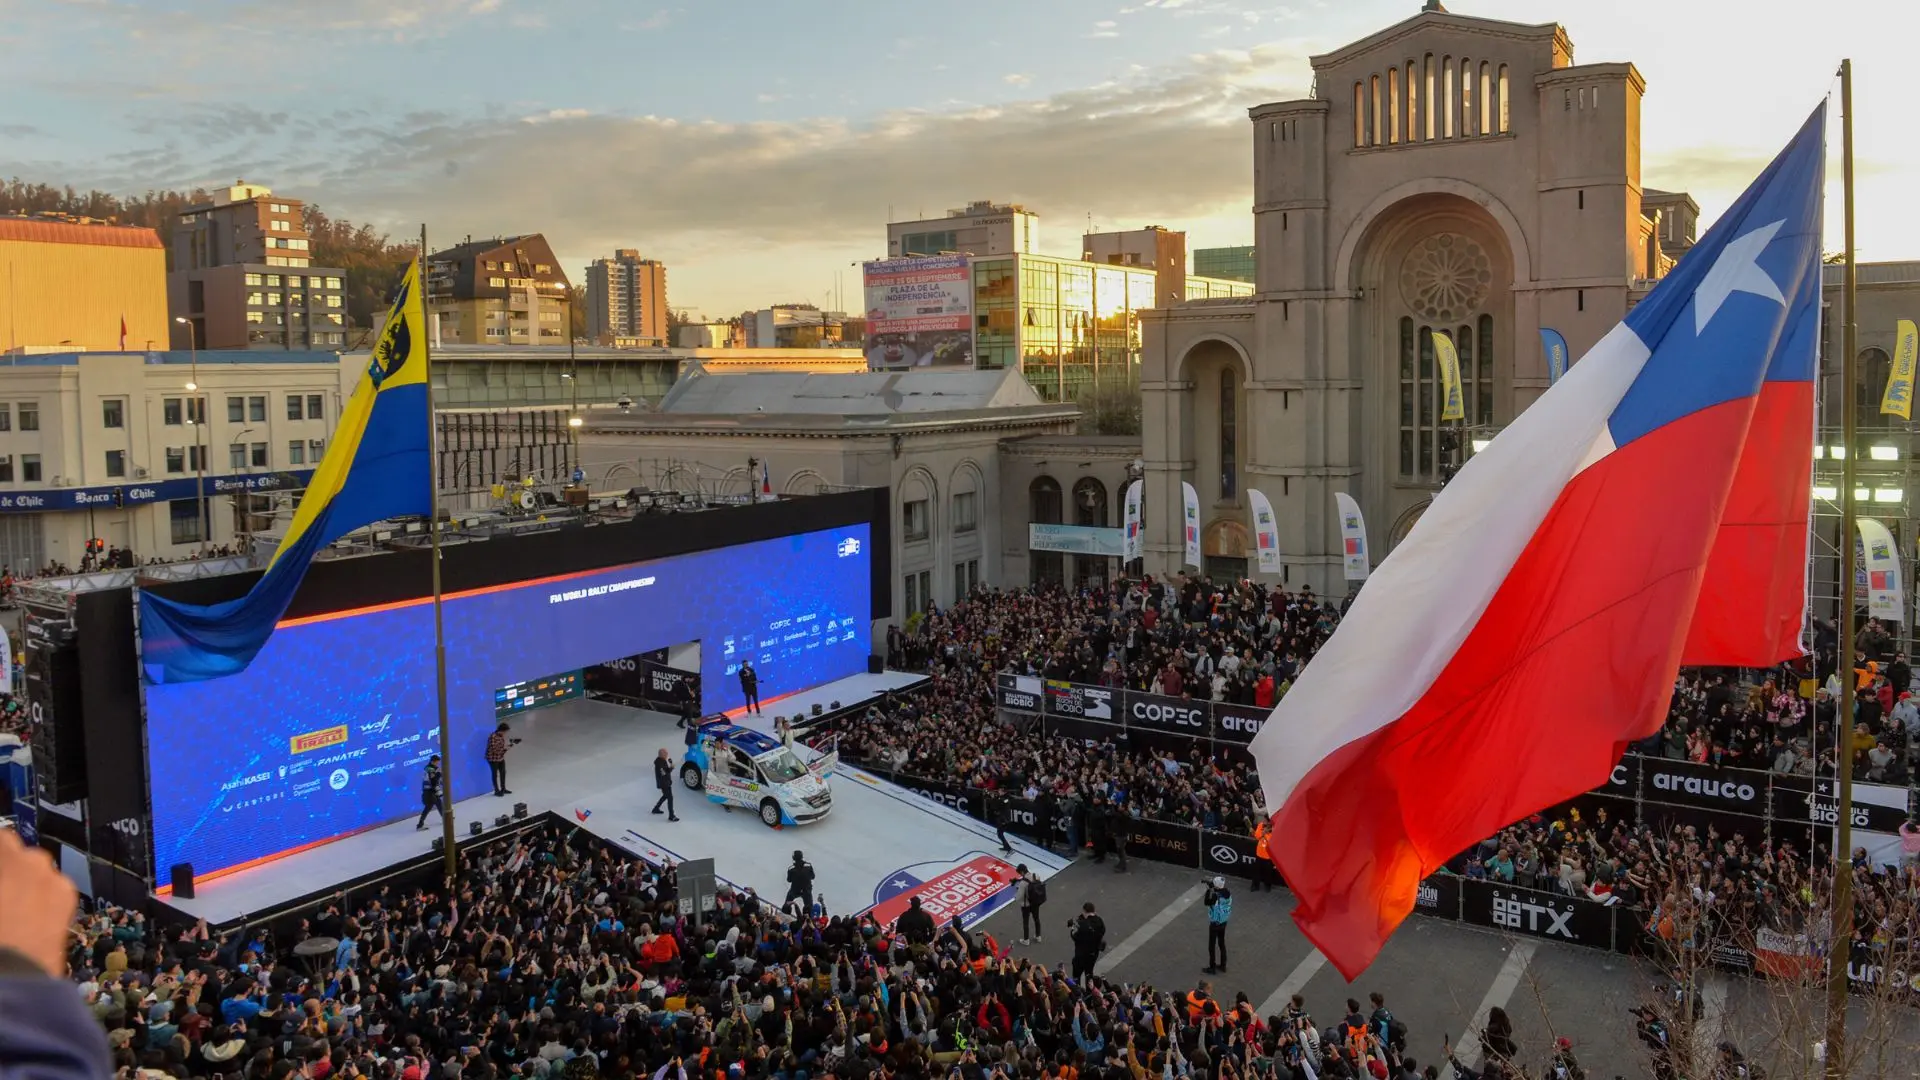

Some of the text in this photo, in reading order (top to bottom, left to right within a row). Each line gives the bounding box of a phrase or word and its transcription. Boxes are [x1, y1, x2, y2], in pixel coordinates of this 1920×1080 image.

[918, 272, 962, 282] SEPTIEMBRE
[885, 291, 946, 301] INDEPENDENCIA
[890, 285, 916, 293] PLAZA
[929, 283, 940, 291] LA
[215, 476, 281, 490] Banco de Chile
[2, 495, 45, 507] de Chile
[75, 491, 110, 503] Banco
[129, 488, 156, 500] Chile
[550, 576, 656, 604] FIA WORLD RALLY CHAMPIONSHIP
[770, 619, 792, 631] COPEC
[652, 670, 682, 681] RALLYCH
[1132, 702, 1202, 727] COPEC
[1222, 715, 1262, 733] arau
[296, 727, 344, 751] PIRELLI
[317, 747, 368, 766] FANATEC
[1652, 772, 1756, 801] arauco
[1154, 838, 1188, 851] YEARS
[907, 866, 977, 904] ALLYCHILE
[965, 893, 984, 906] SEPT
[985, 881, 1004, 894] 2024
[1493, 890, 1575, 912] GRUPO
[1521, 902, 1574, 938] TX
